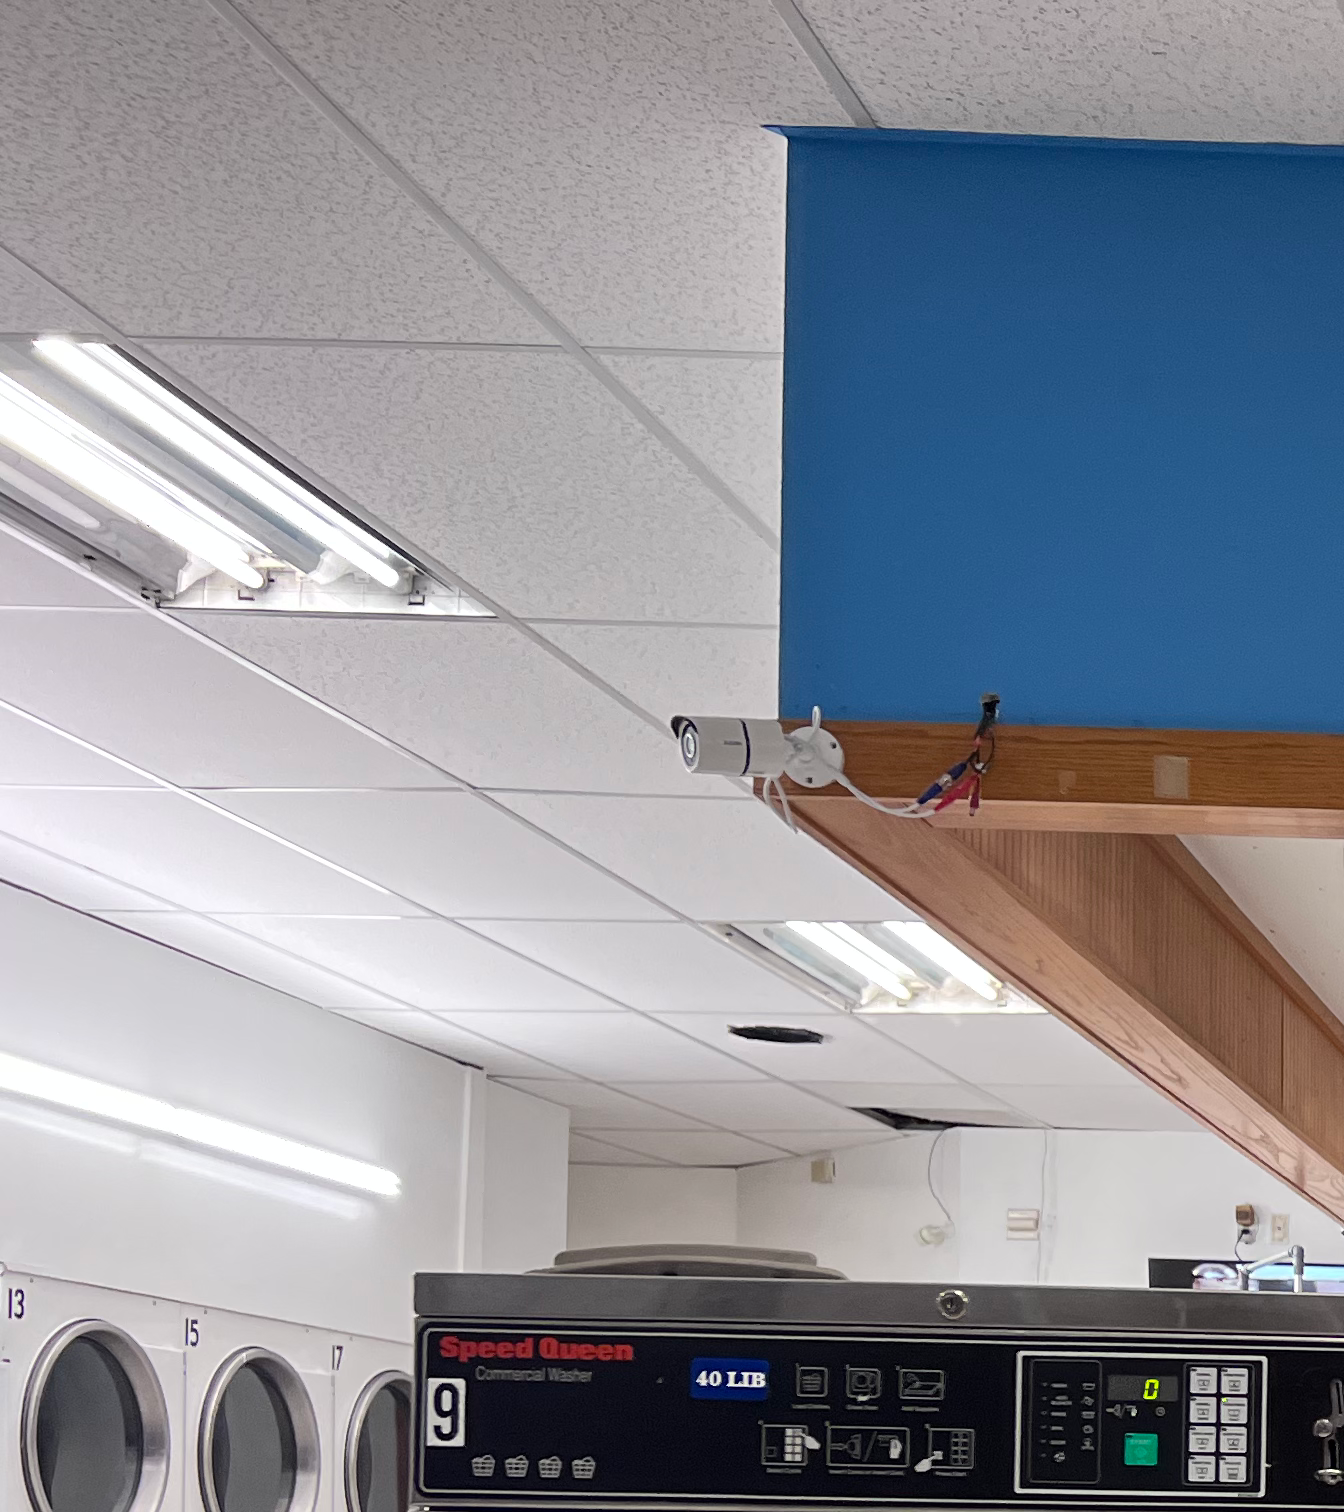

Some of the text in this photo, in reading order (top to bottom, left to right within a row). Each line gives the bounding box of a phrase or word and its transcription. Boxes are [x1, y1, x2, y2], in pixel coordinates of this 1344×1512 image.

[7, 1287, 25, 1320] 13
[184, 1316, 201, 1348] 15
[331, 1345, 345, 1371] 17
[438, 1335, 636, 1363] Speed Queen
[474, 1364, 593, 1383] Commercial Washer
[695, 1369, 767, 1389] 40 LIB
[433, 1381, 461, 1441] 9
